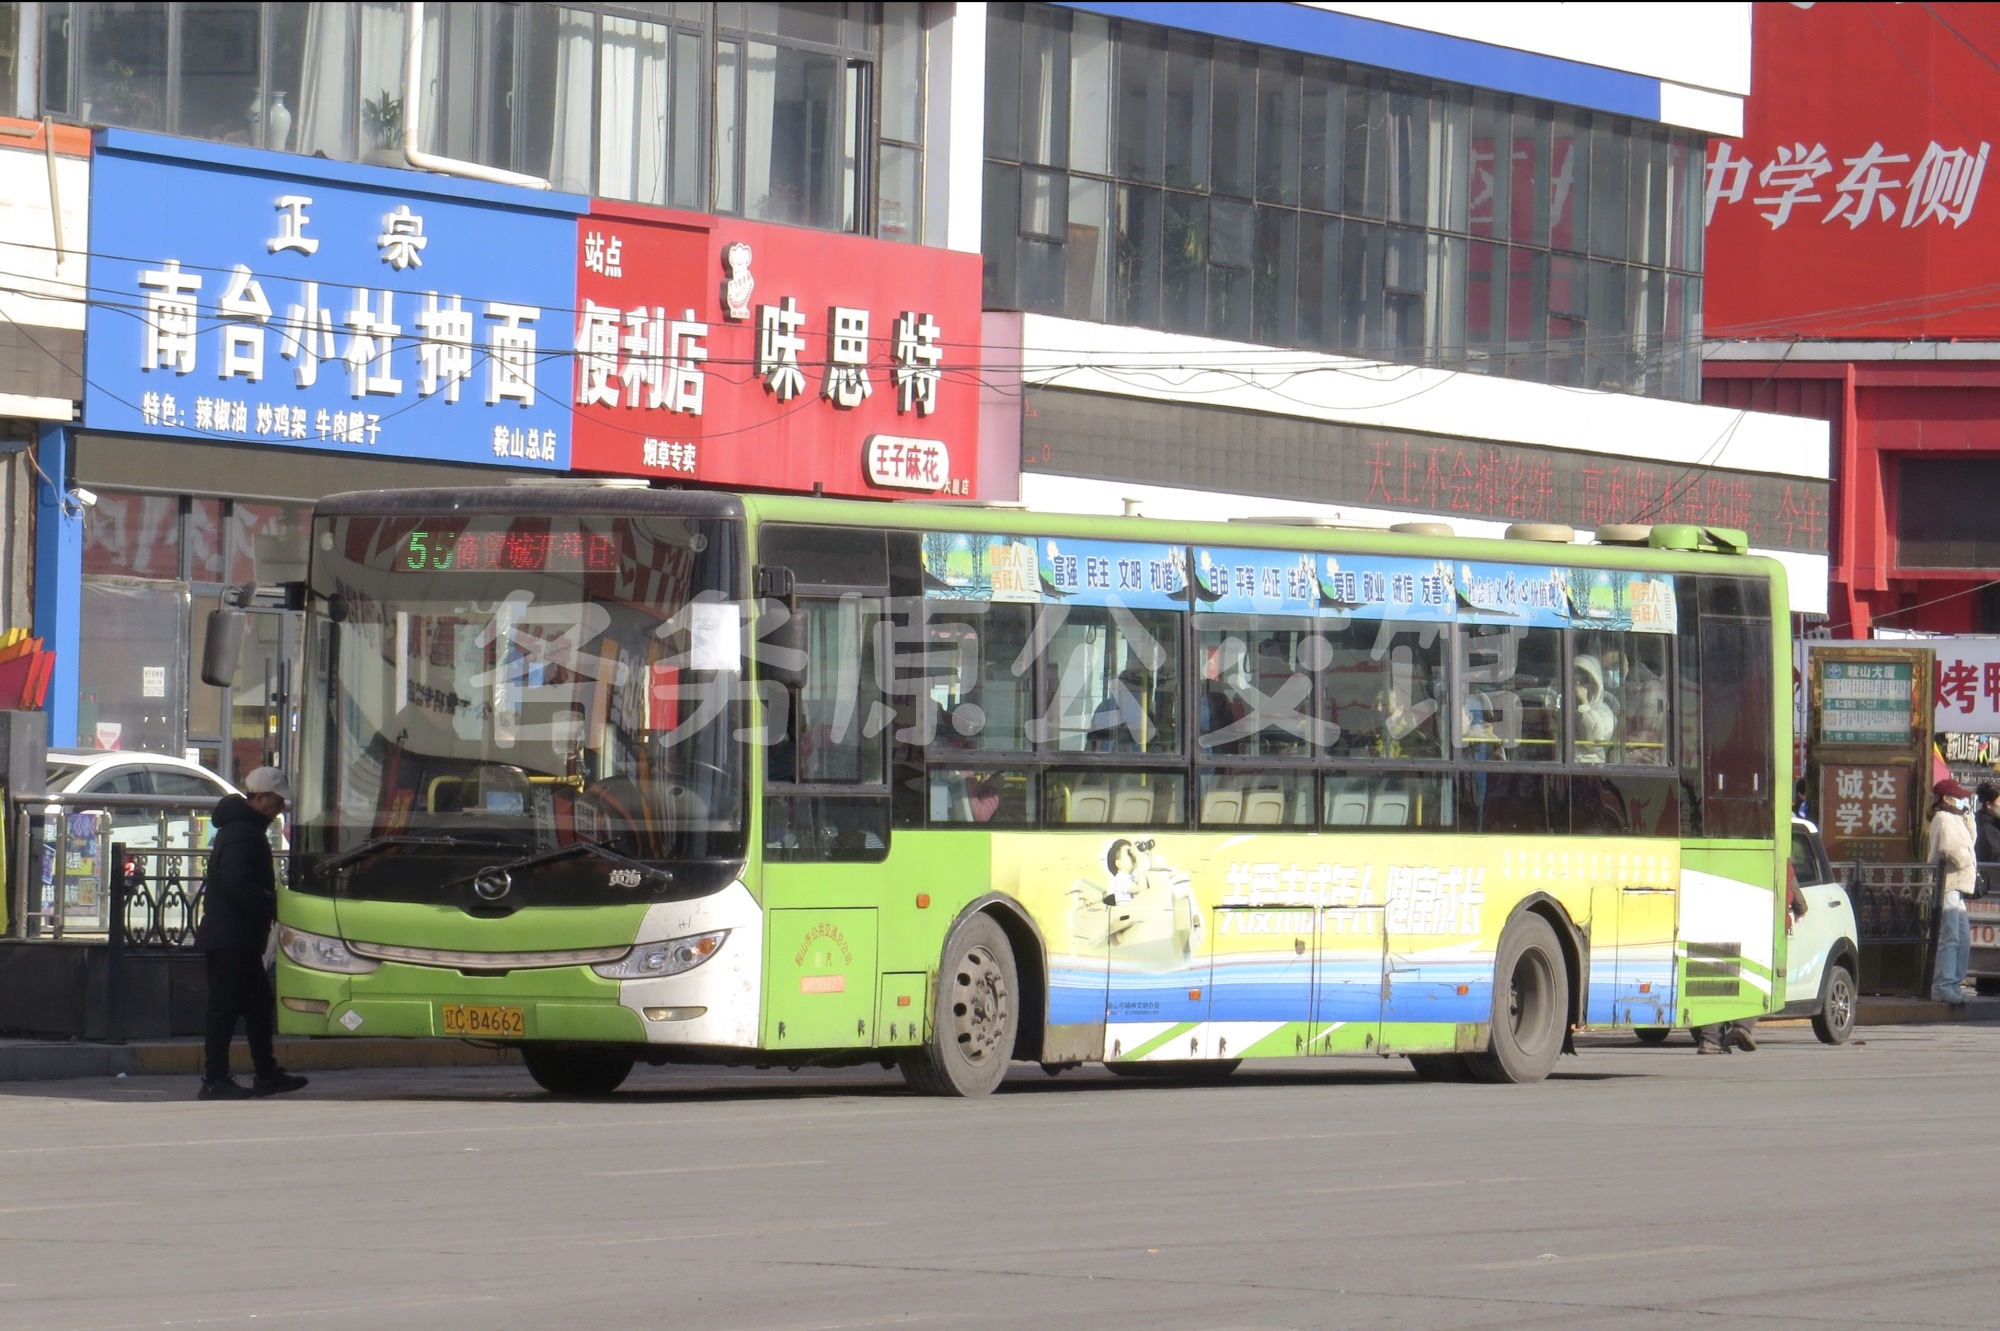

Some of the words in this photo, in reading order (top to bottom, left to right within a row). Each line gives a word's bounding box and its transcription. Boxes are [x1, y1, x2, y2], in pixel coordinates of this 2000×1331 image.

[1705, 140, 1991, 231] 中学东侧
[267, 194, 428, 269] 正宗
[583, 231, 624, 278] 站点
[138, 258, 541, 407] 南台小杜抽面
[573, 298, 709, 416] 便利店
[758, 296, 943, 416] 味思特
[256, 402, 307, 439] 炒鸡架
[493, 426, 556, 461] 鞍山总店
[642, 437, 697, 473] 烟草专卖
[876, 444, 940, 483] 王子麻花
[1053, 555, 1079, 588] 富强
[1087, 556, 1110, 588] 民主
[1119, 557, 1142, 590] 文明
[1150, 559, 1174, 592] 和谐
[1208, 565, 1230, 596] 自由
[1236, 565, 1255, 598] 平等
[1261, 566, 1281, 599] 公正
[1287, 567, 1308, 600] 法治
[1333, 572, 1356, 603] 爱国
[1363, 571, 1385, 604] 敬业
[1391, 573, 1414, 604] 诚信
[1420, 574, 1443, 606] 友善
[1847, 665, 1896, 679] 鞍山大厦
[1935, 659, 2000, 714] 烤
[1835, 769, 1897, 800] 诚达
[1835, 803, 1897, 834] 学校
[608, 868, 642, 888] 黄海
